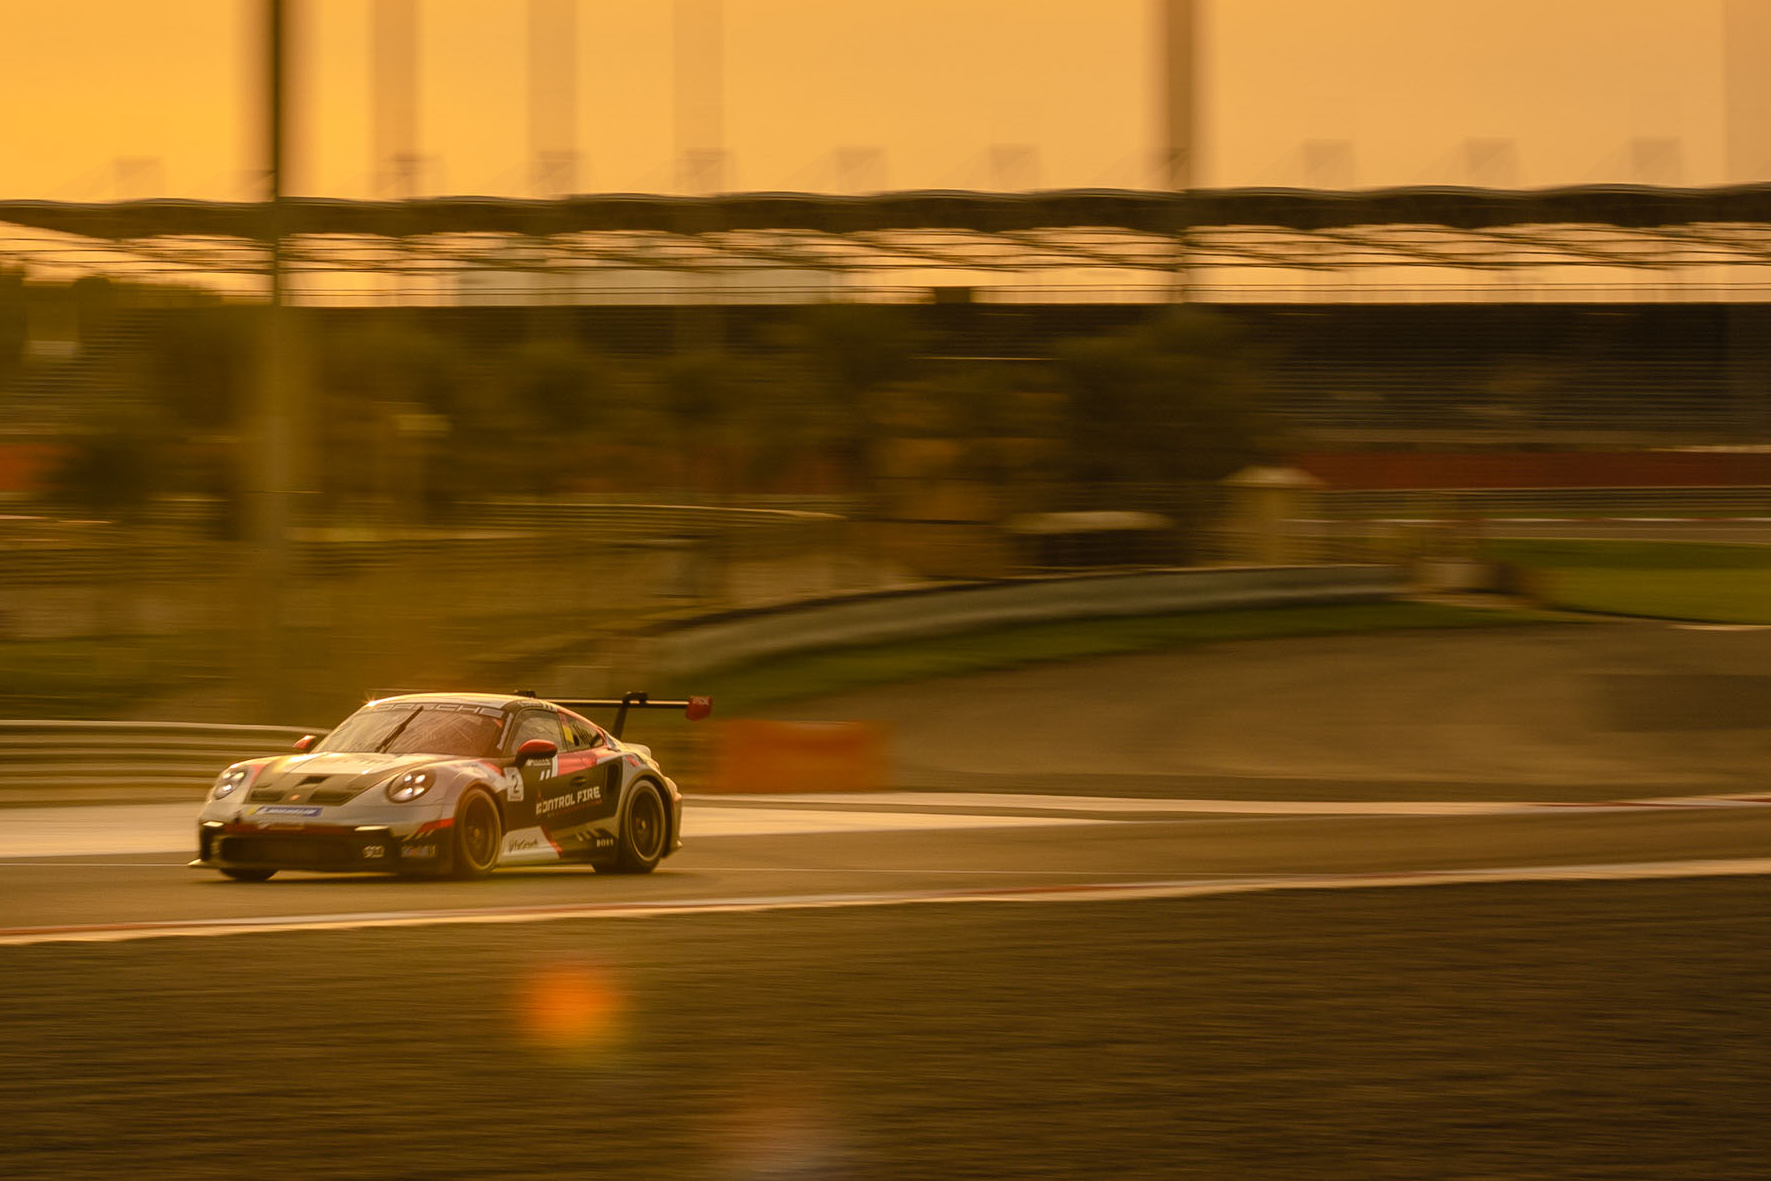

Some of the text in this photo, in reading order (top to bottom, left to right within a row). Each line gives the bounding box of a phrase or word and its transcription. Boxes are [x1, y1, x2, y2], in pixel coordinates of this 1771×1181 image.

[511, 774, 520, 794] 2
[535, 794, 576, 816] CONTROL
[577, 785, 602, 804] FIRE
